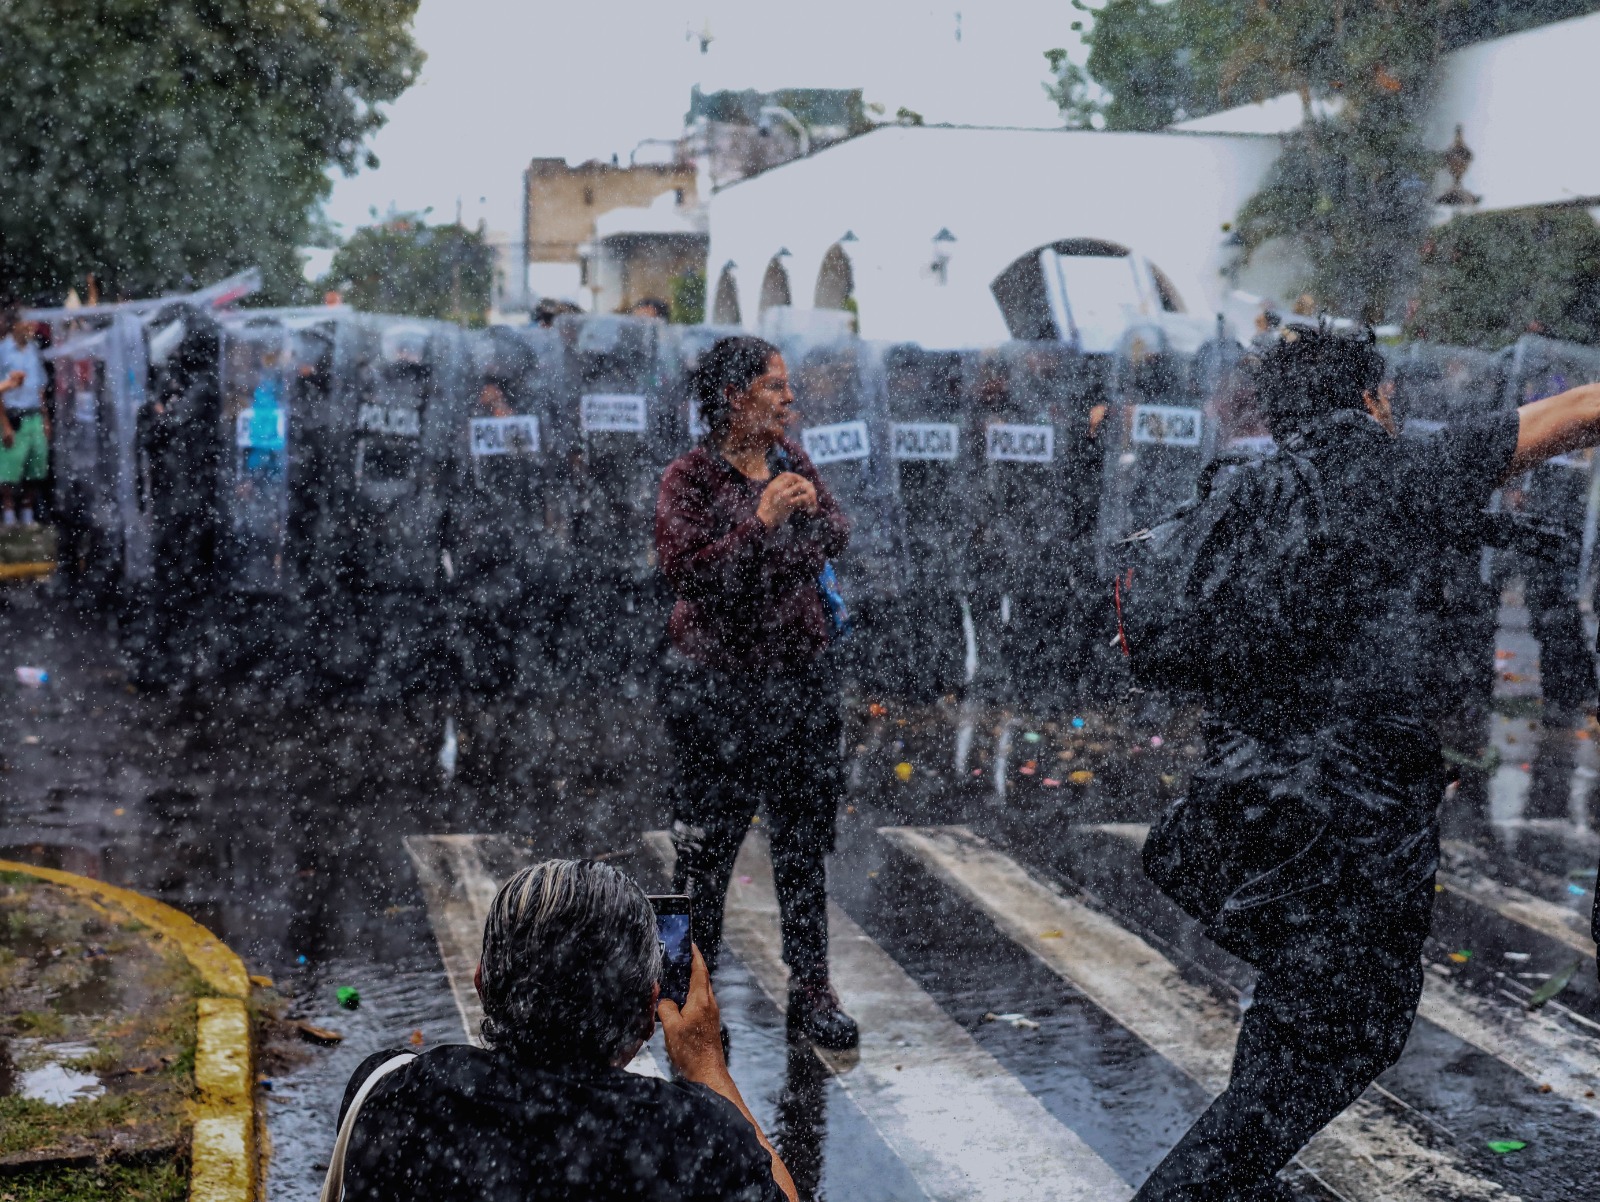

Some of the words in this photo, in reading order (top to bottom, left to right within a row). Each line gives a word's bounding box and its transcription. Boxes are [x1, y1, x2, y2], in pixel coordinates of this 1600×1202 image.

[806, 426, 863, 456] POLICIA
[894, 428, 951, 454] POLICIA
[991, 427, 1048, 456] POLICIA
